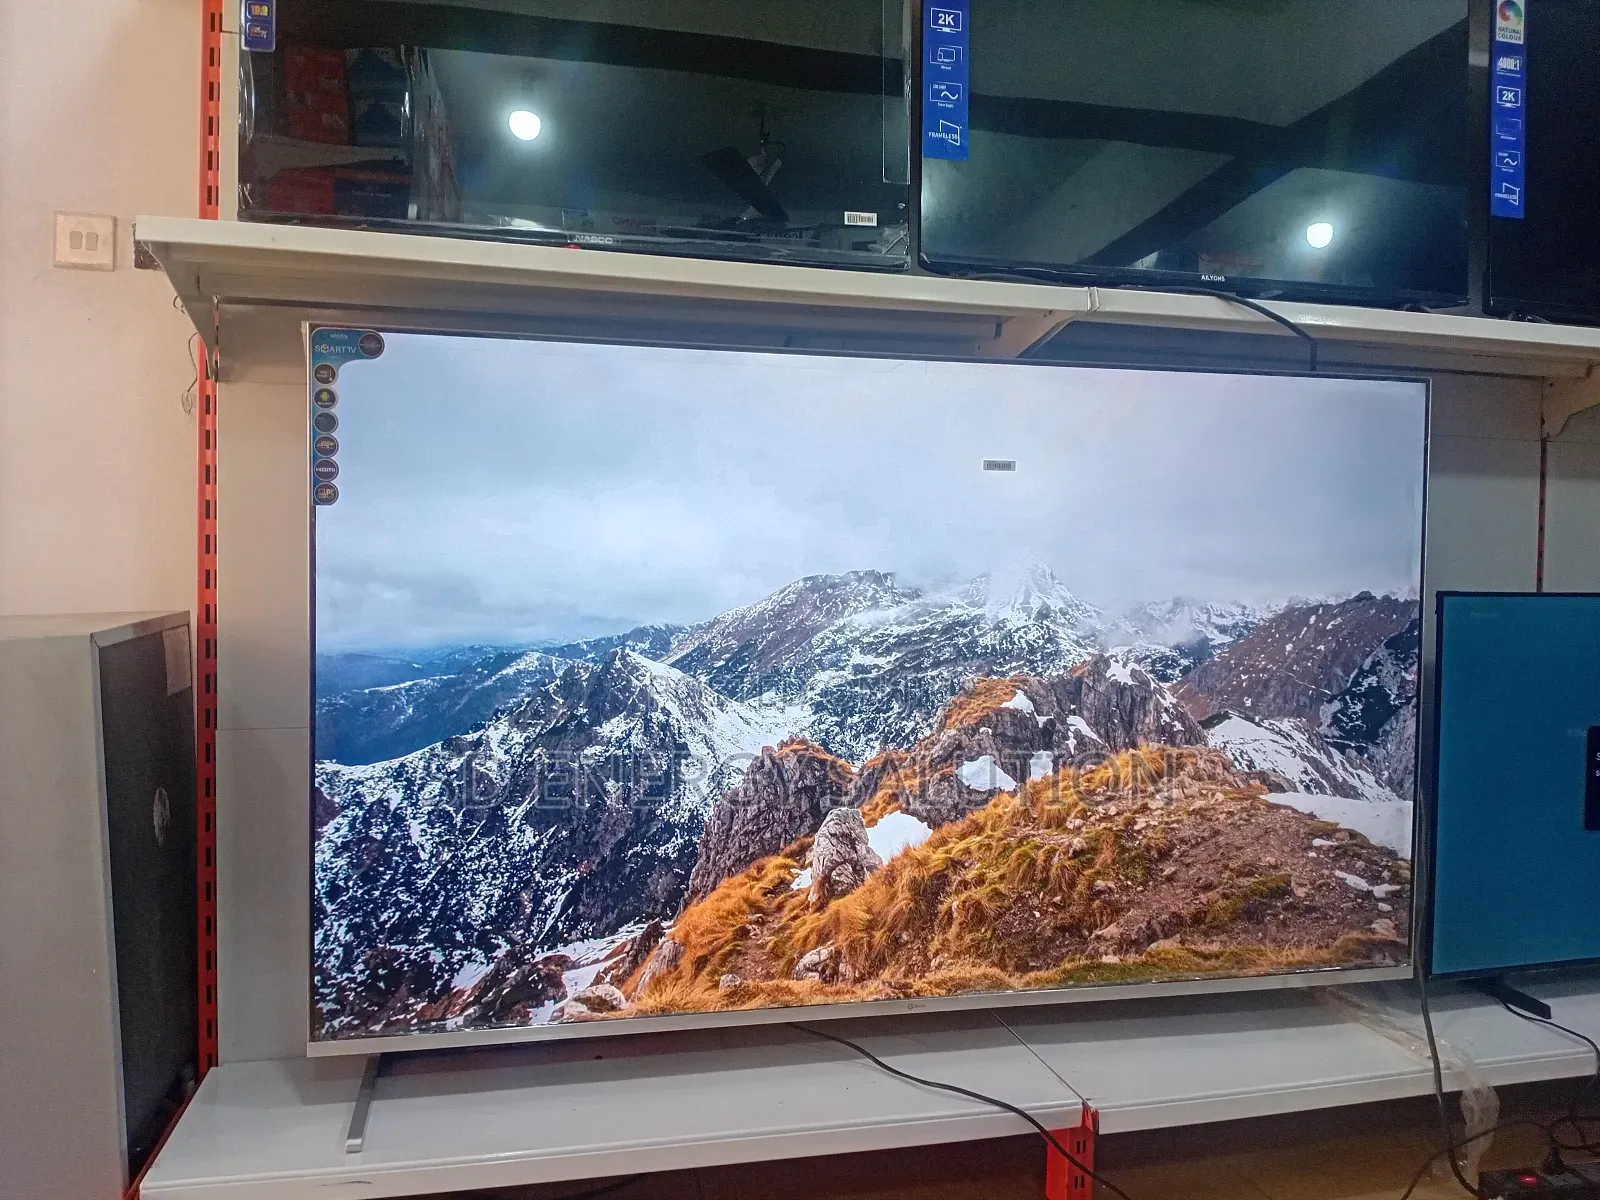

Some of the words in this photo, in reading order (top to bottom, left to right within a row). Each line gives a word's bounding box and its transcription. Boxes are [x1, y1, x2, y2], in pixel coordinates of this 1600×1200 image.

[938, 13, 955, 26] 2K
[1498, 27, 1522, 36] NATURAL
[1498, 33, 1522, 42] COLOUR
[1502, 90, 1515, 102] 2K
[928, 131, 959, 140] FRAMELESS
[574, 235, 613, 244] NASCO
[346, 346, 357, 354] TV
